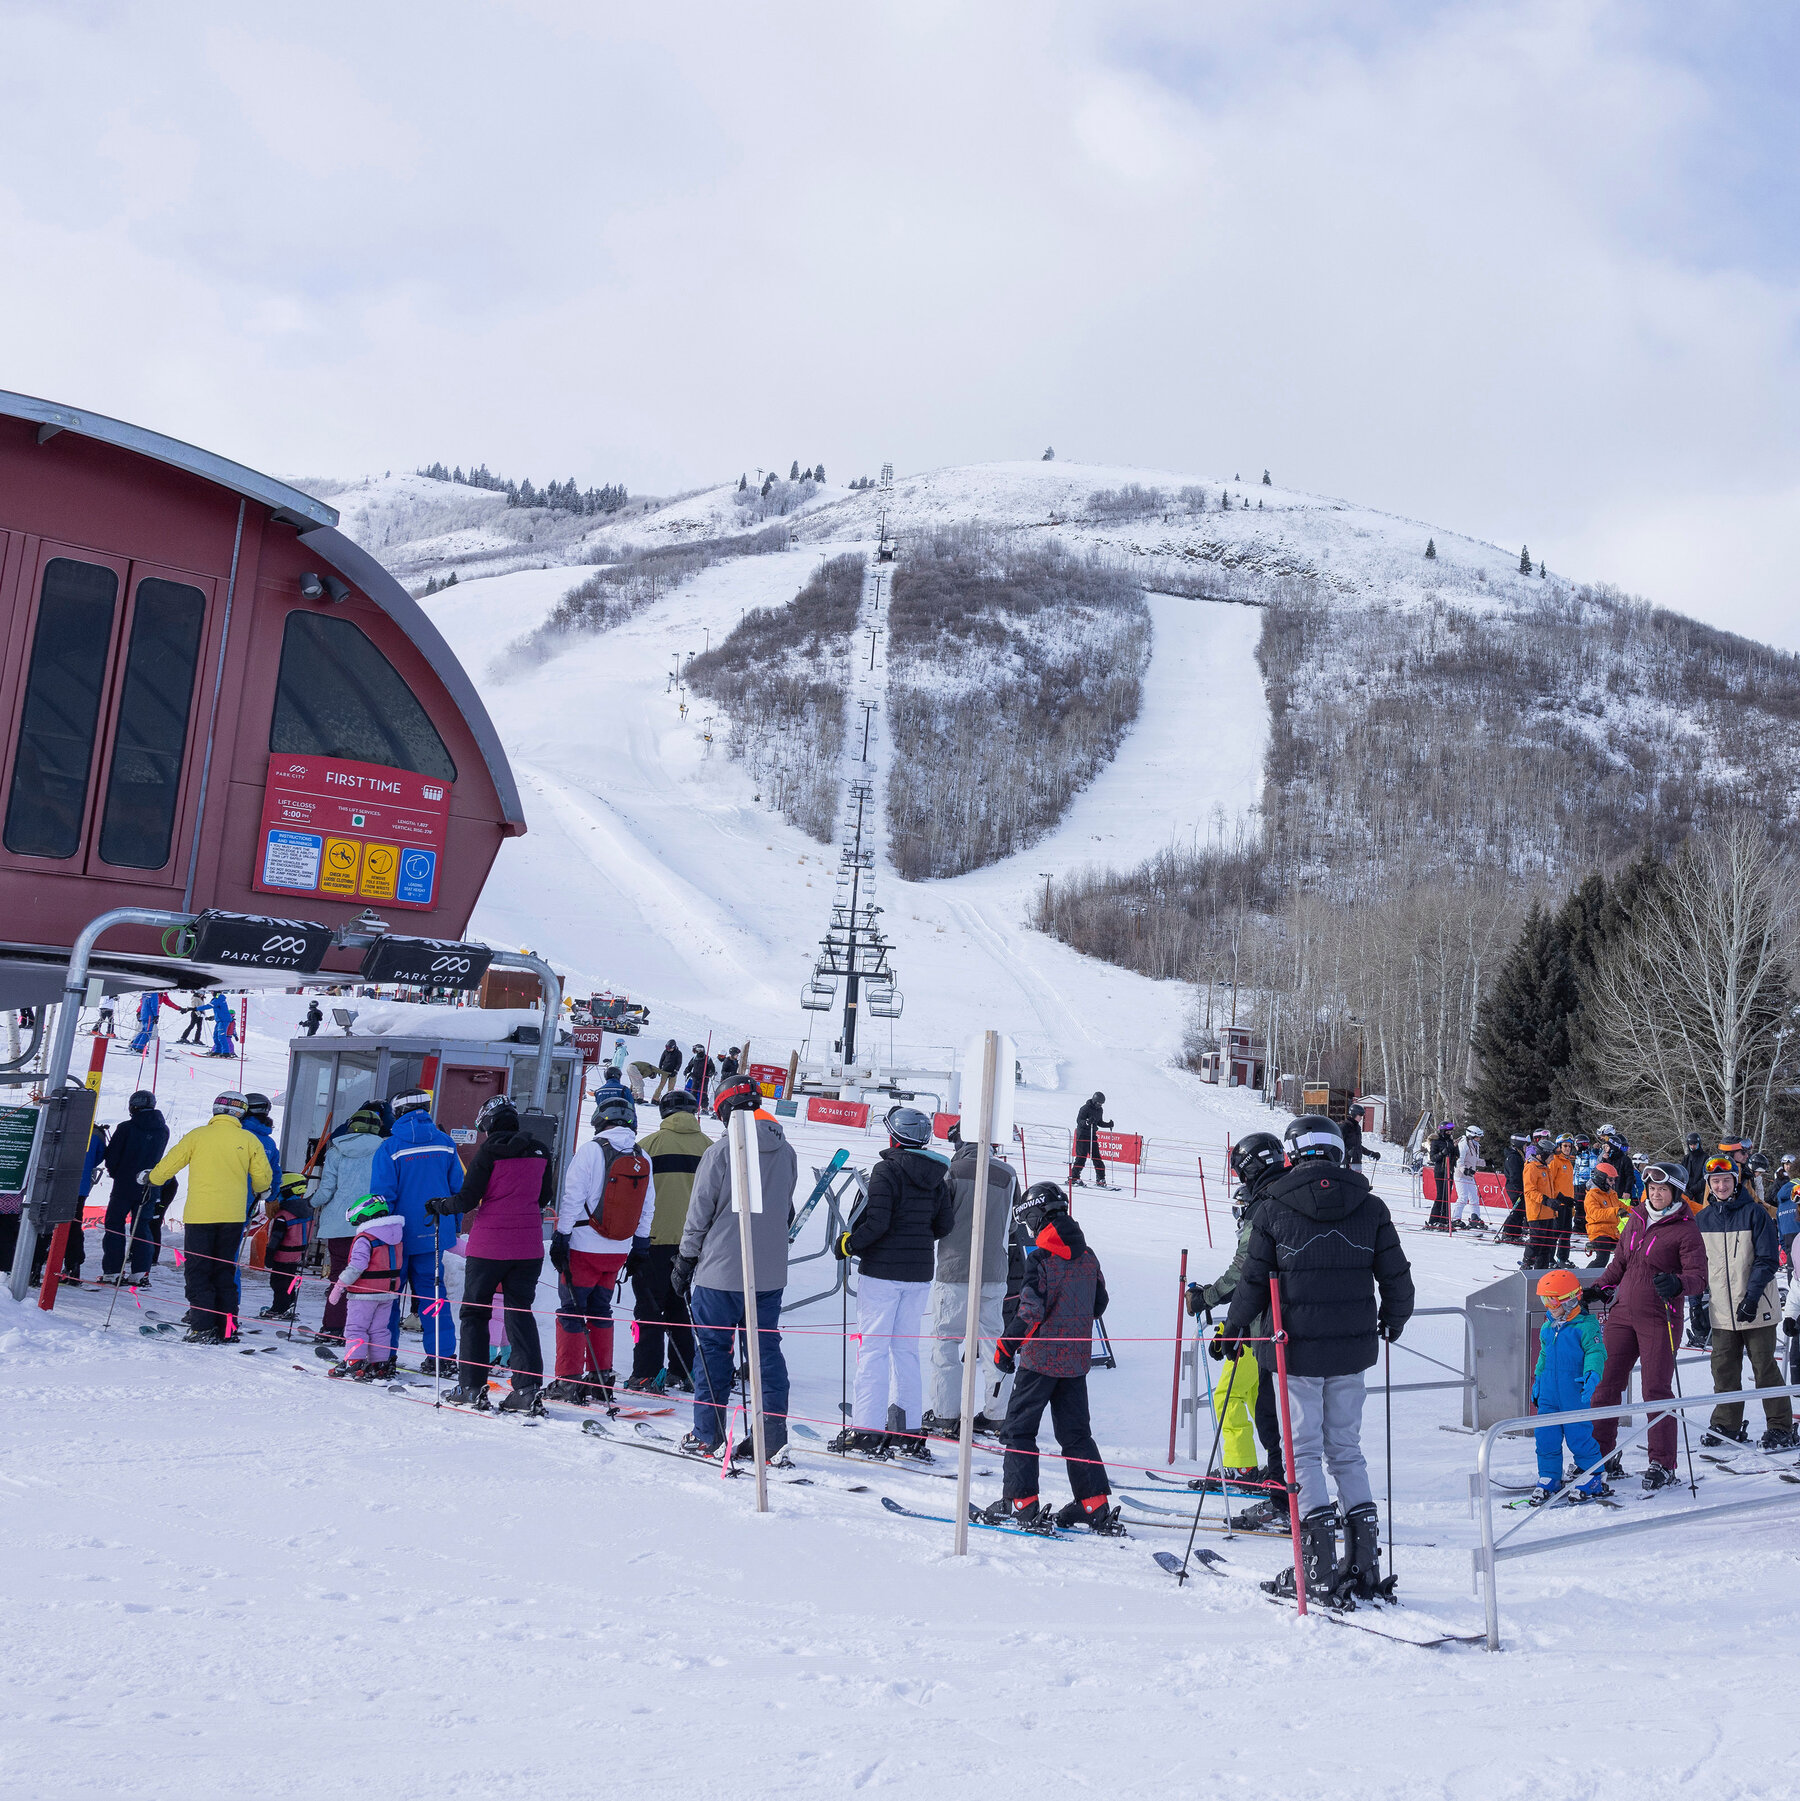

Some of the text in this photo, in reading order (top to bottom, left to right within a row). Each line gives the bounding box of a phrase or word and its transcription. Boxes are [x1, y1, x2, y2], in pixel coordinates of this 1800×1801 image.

[326, 771, 402, 794] FIRST TIME
[292, 801, 316, 809] CLOSES
[283, 810, 301, 818] 4:00
[279, 833, 312, 842] INSTRUCTIONS
[221, 950, 300, 966] PARK CITY
[394, 971, 464, 984] PARK CITY
[581, 1048, 594, 1056] NLY
[1483, 1185, 1505, 1194] CITY
[1015, 1196, 1045, 1214] FINDWAY
